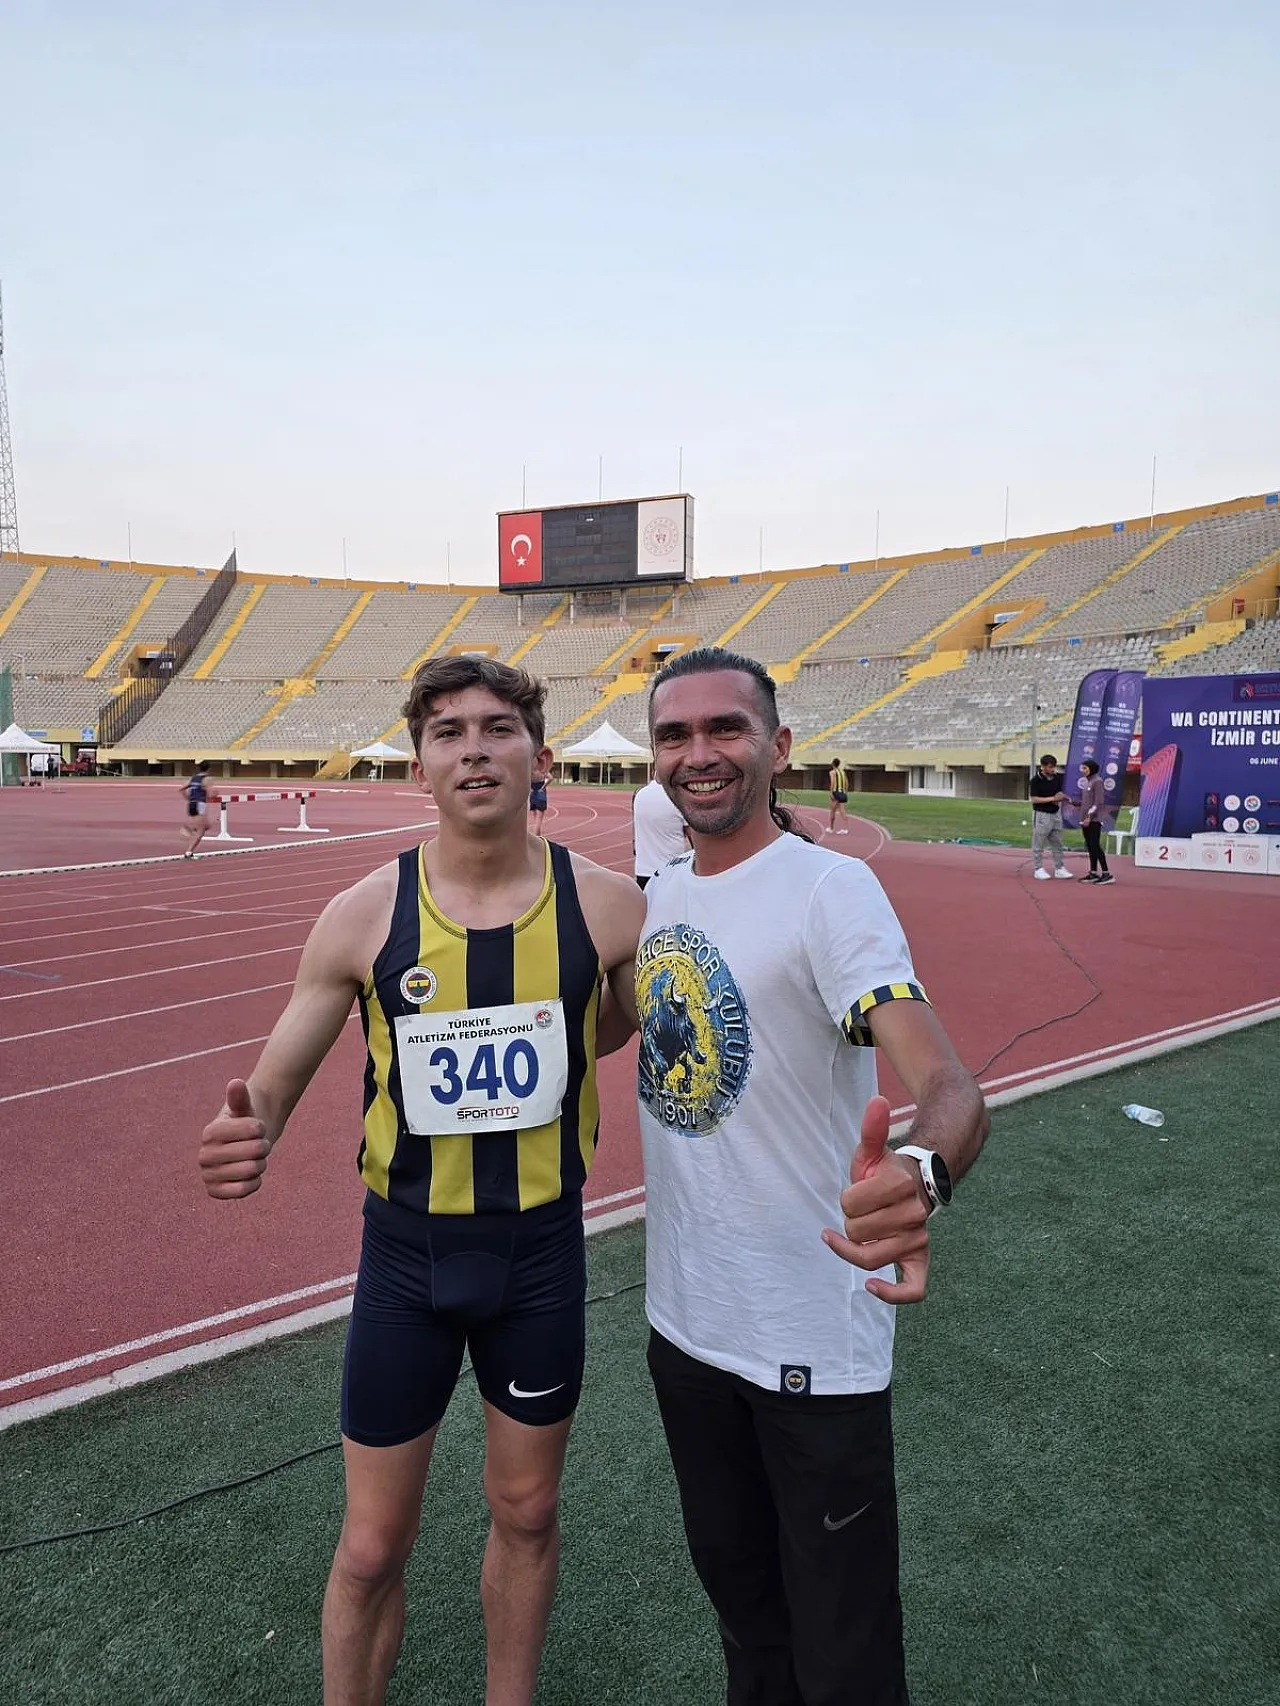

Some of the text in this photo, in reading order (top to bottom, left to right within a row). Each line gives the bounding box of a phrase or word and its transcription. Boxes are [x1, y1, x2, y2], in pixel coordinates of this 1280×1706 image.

[1171, 709, 1280, 727] WA CONTINENT
[1211, 727, 1255, 746] İZMİR
[1260, 757, 1279, 765] JUNE
[1158, 845, 1169, 861] 2
[1224, 848, 1232, 864] 1
[679, 931, 720, 980] SPOR
[448, 1016, 491, 1030] TÜRKİYE
[407, 1023, 533, 1044] ATLETİZM FEDERASYONU
[429, 1038, 539, 1105] 340
